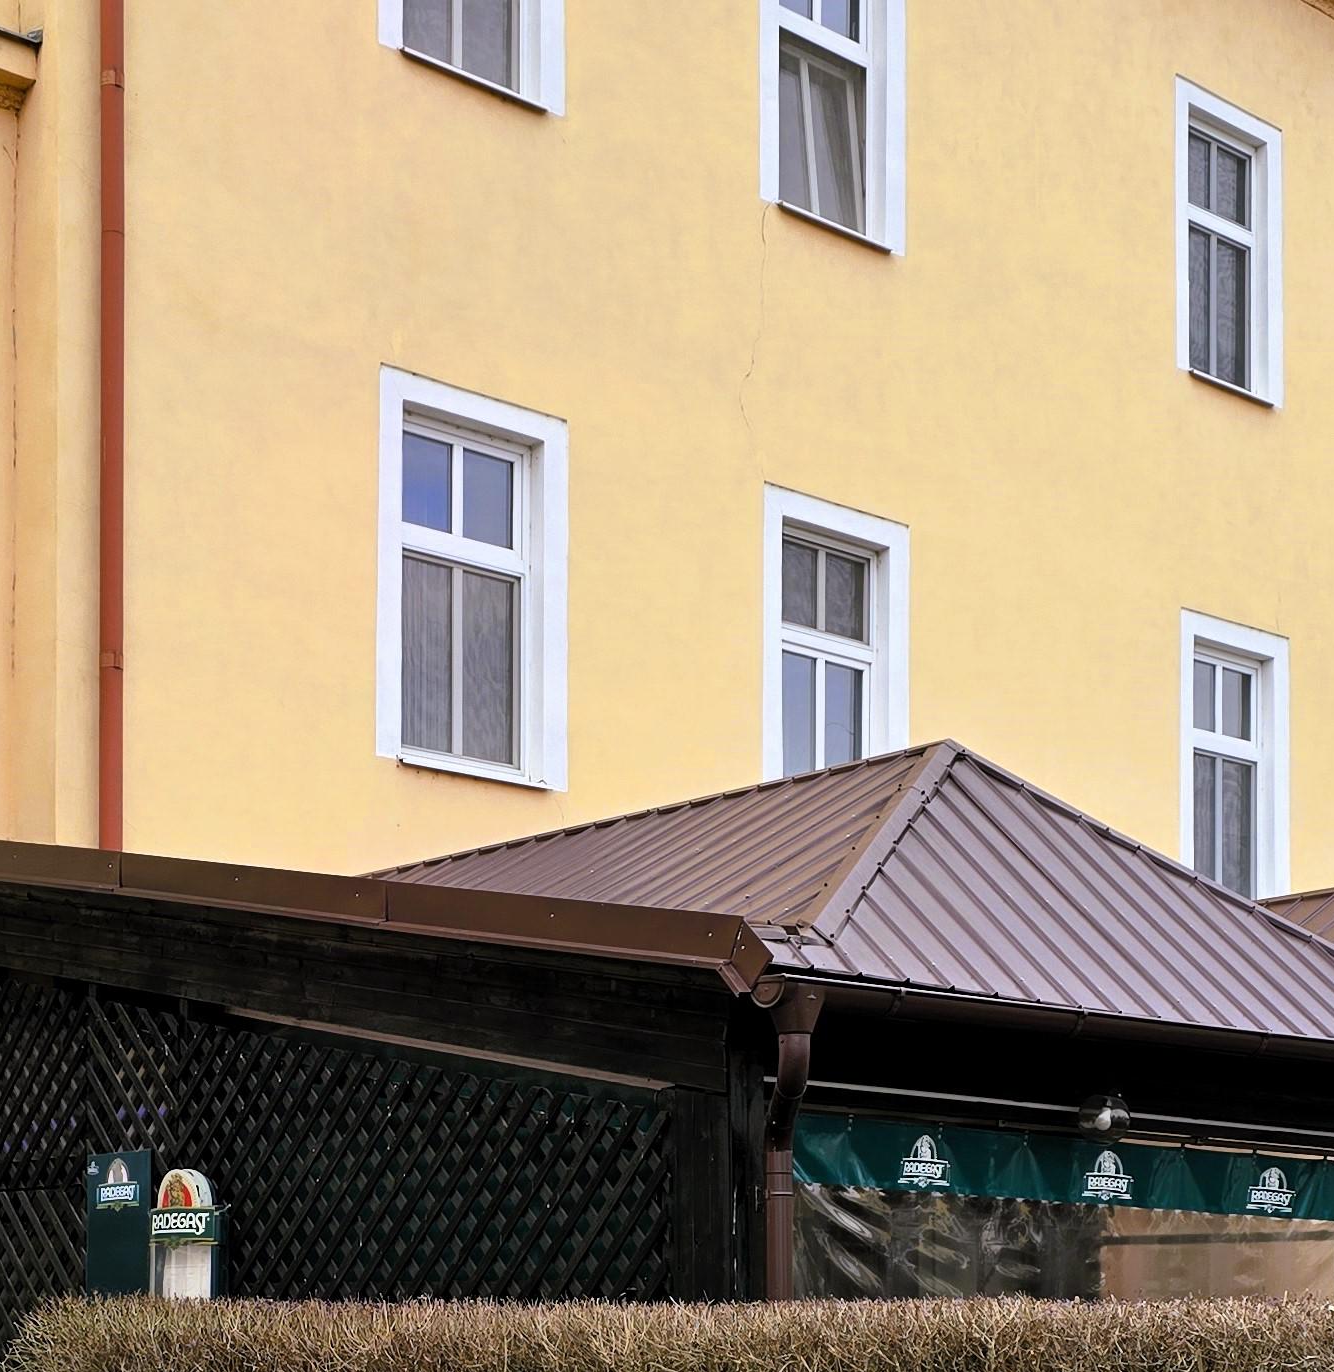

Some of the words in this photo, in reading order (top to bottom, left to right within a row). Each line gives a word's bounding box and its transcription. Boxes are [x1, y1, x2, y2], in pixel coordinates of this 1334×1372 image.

[903, 1161, 945, 1179] RADEGAST
[1087, 1176, 1129, 1193] RADEGAST
[1250, 1190, 1292, 1206] RADEGAST
[152, 1212, 210, 1235] RADEGAST
